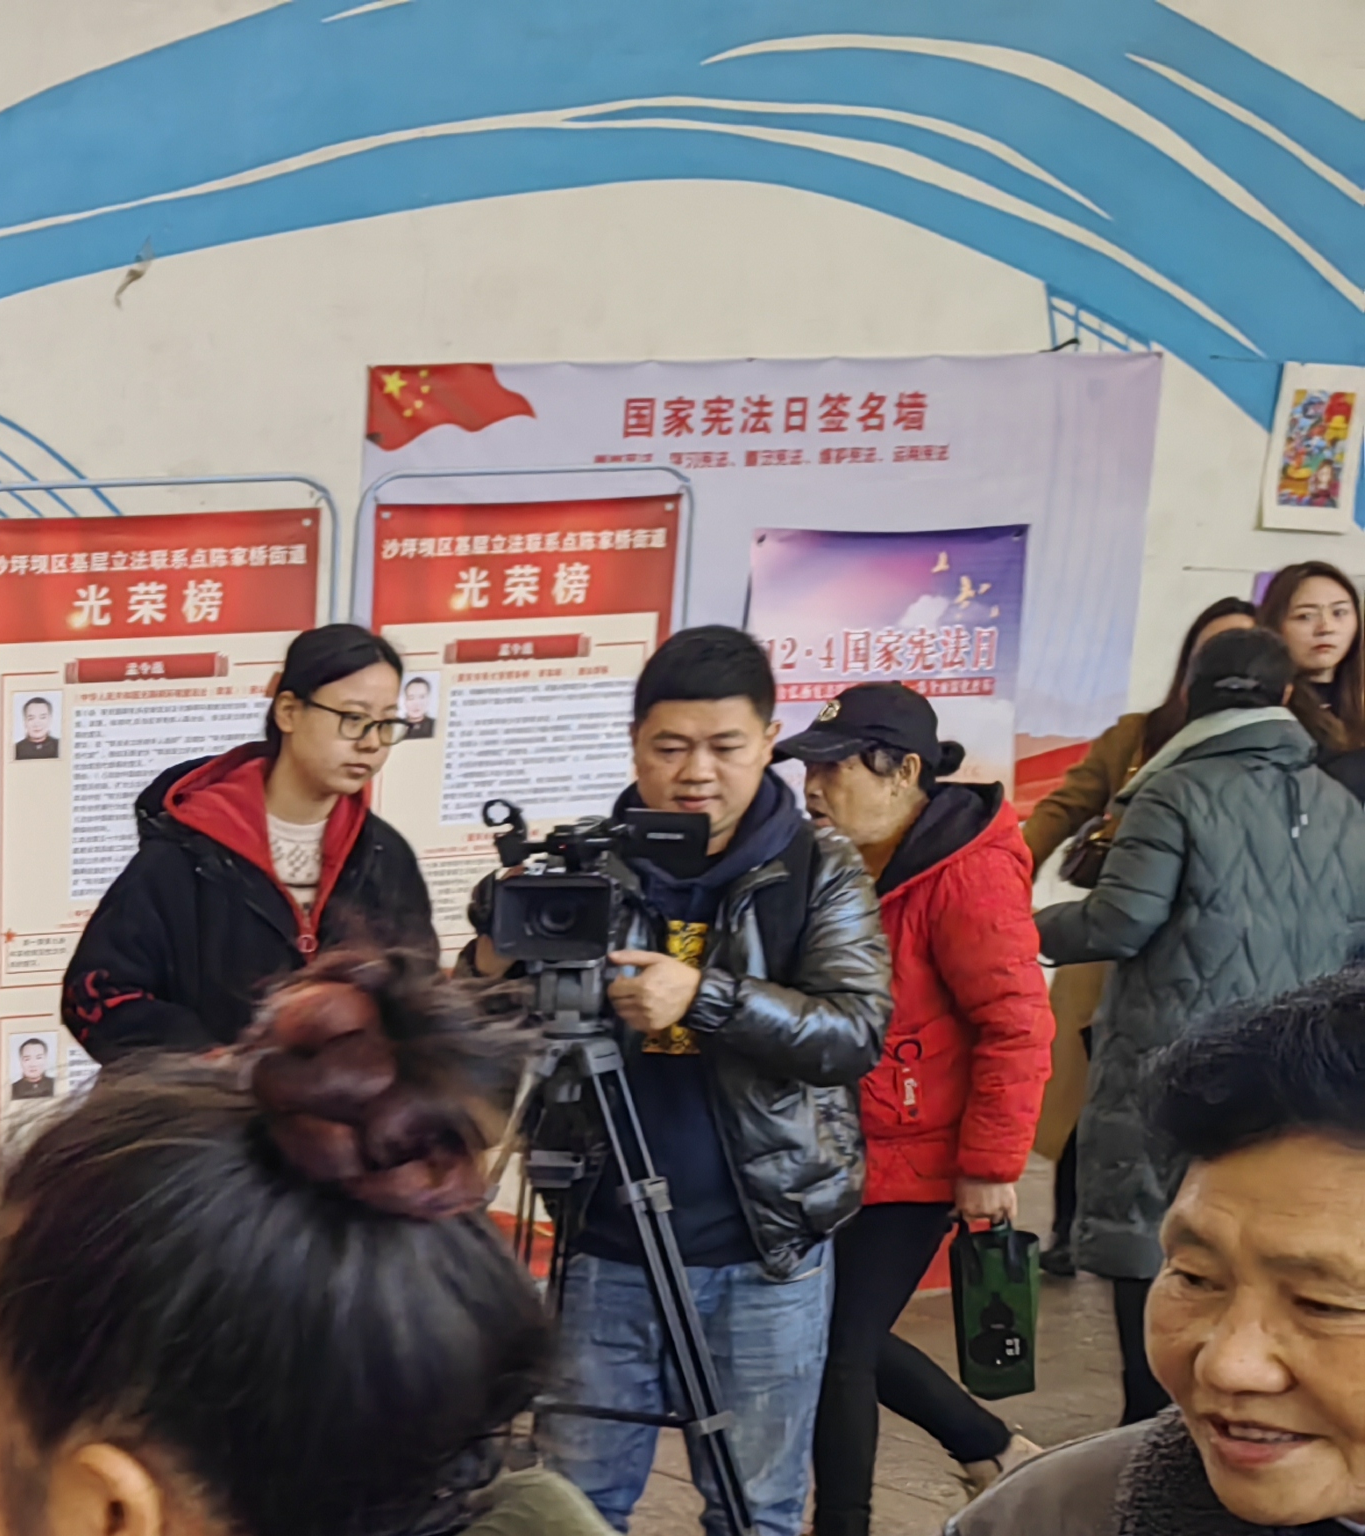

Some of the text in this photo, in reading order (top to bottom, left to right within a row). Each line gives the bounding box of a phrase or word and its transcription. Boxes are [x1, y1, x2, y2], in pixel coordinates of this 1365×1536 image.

[622, 391, 929, 438] 国家宪法日签名墙
[72, 579, 223, 625] 光荣榜
[454, 562, 591, 608] 光荣榜
